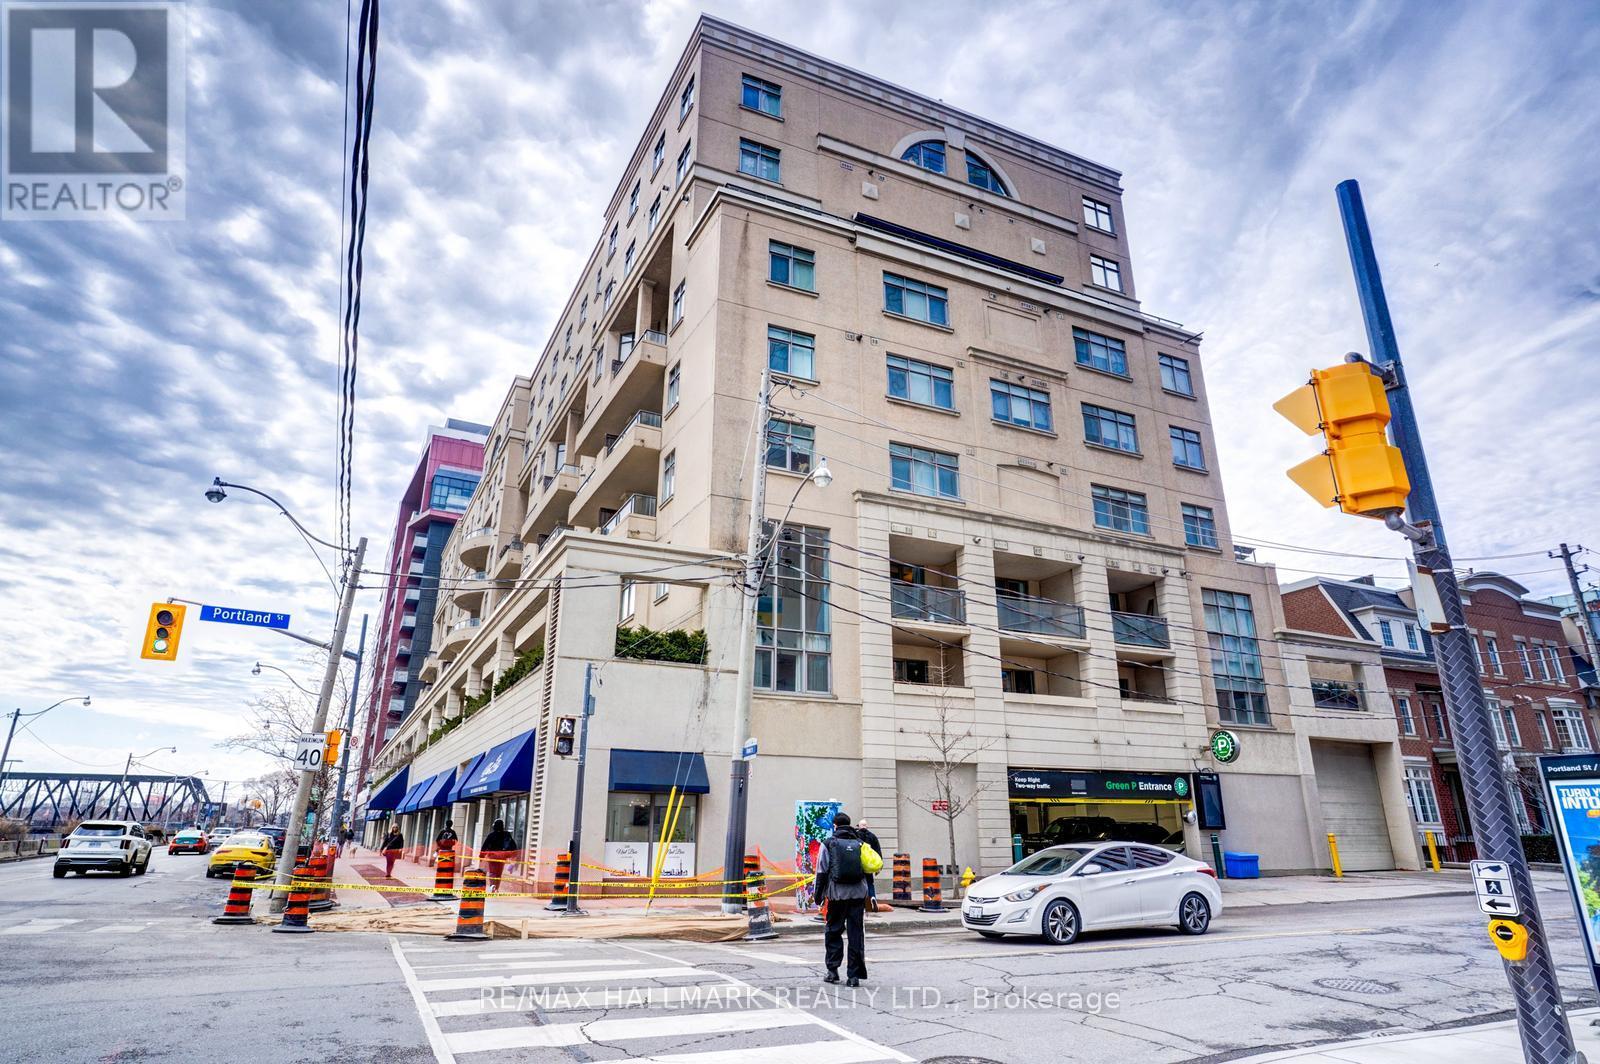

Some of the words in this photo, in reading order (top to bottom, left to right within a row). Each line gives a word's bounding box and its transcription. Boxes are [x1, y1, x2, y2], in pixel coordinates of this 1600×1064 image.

[213, 607, 272, 624] Portland
[296, 748, 321, 766] 40
[1105, 781, 1130, 790] Green
[1131, 781, 1137, 790] P
[1138, 781, 1173, 791] Entrance
[1559, 787, 1591, 797] TURN
[1561, 796, 1600, 810] INTO
